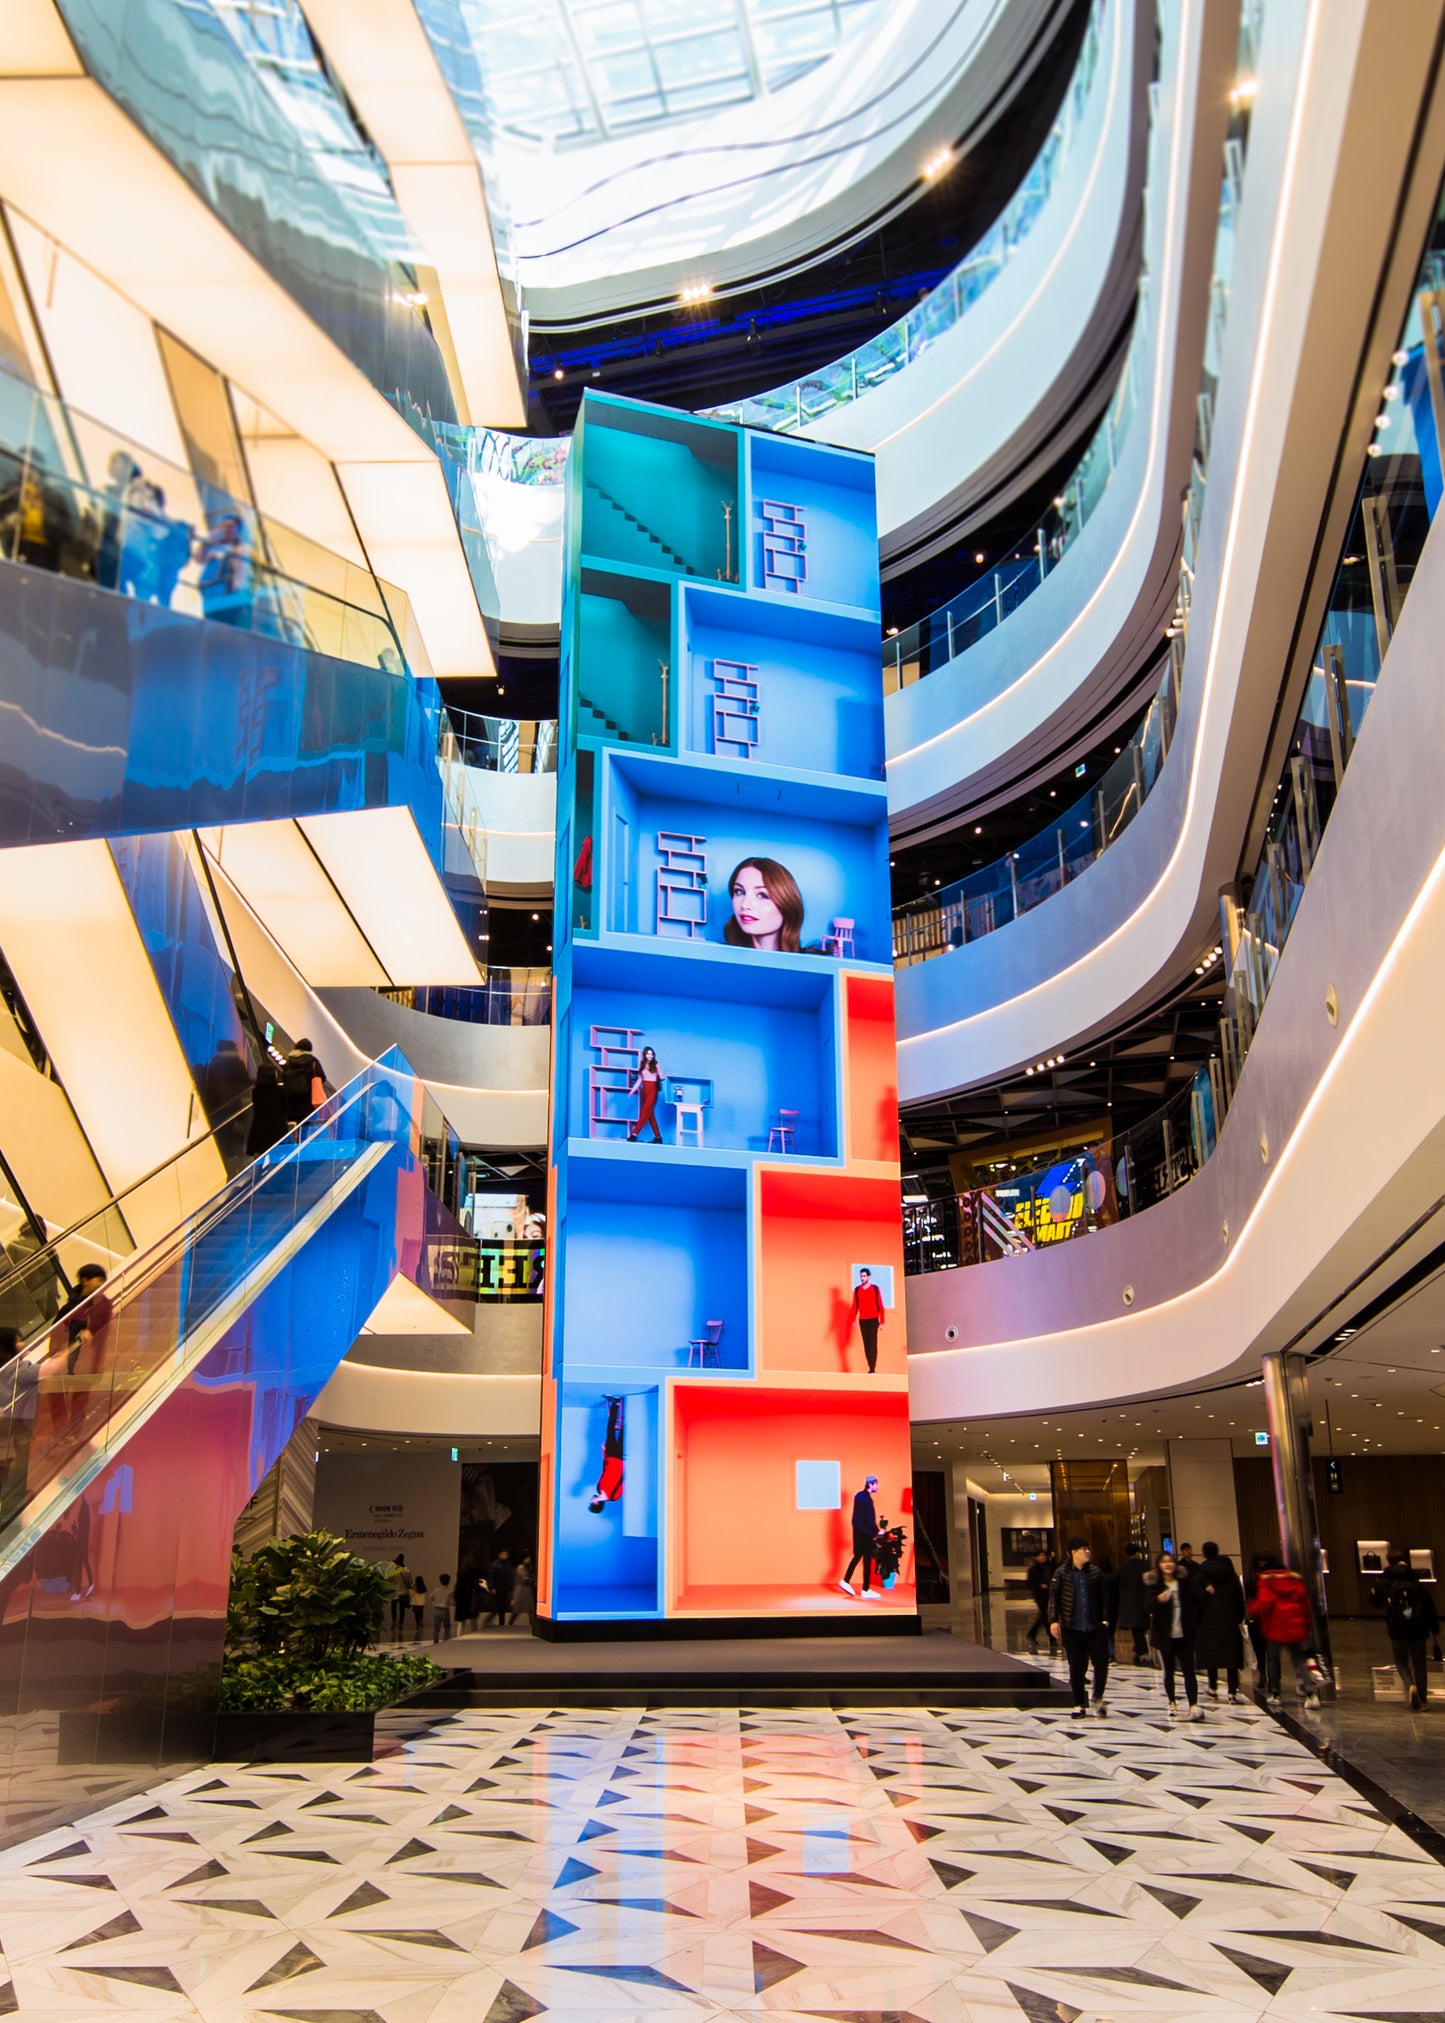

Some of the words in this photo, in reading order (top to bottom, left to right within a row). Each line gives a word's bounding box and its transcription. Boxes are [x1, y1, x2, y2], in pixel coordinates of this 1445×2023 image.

[1014, 1192, 1084, 1230] ELECO
[345, 1529, 397, 1540] Ermenegildo
[398, 1529, 425, 1540] Zegna
